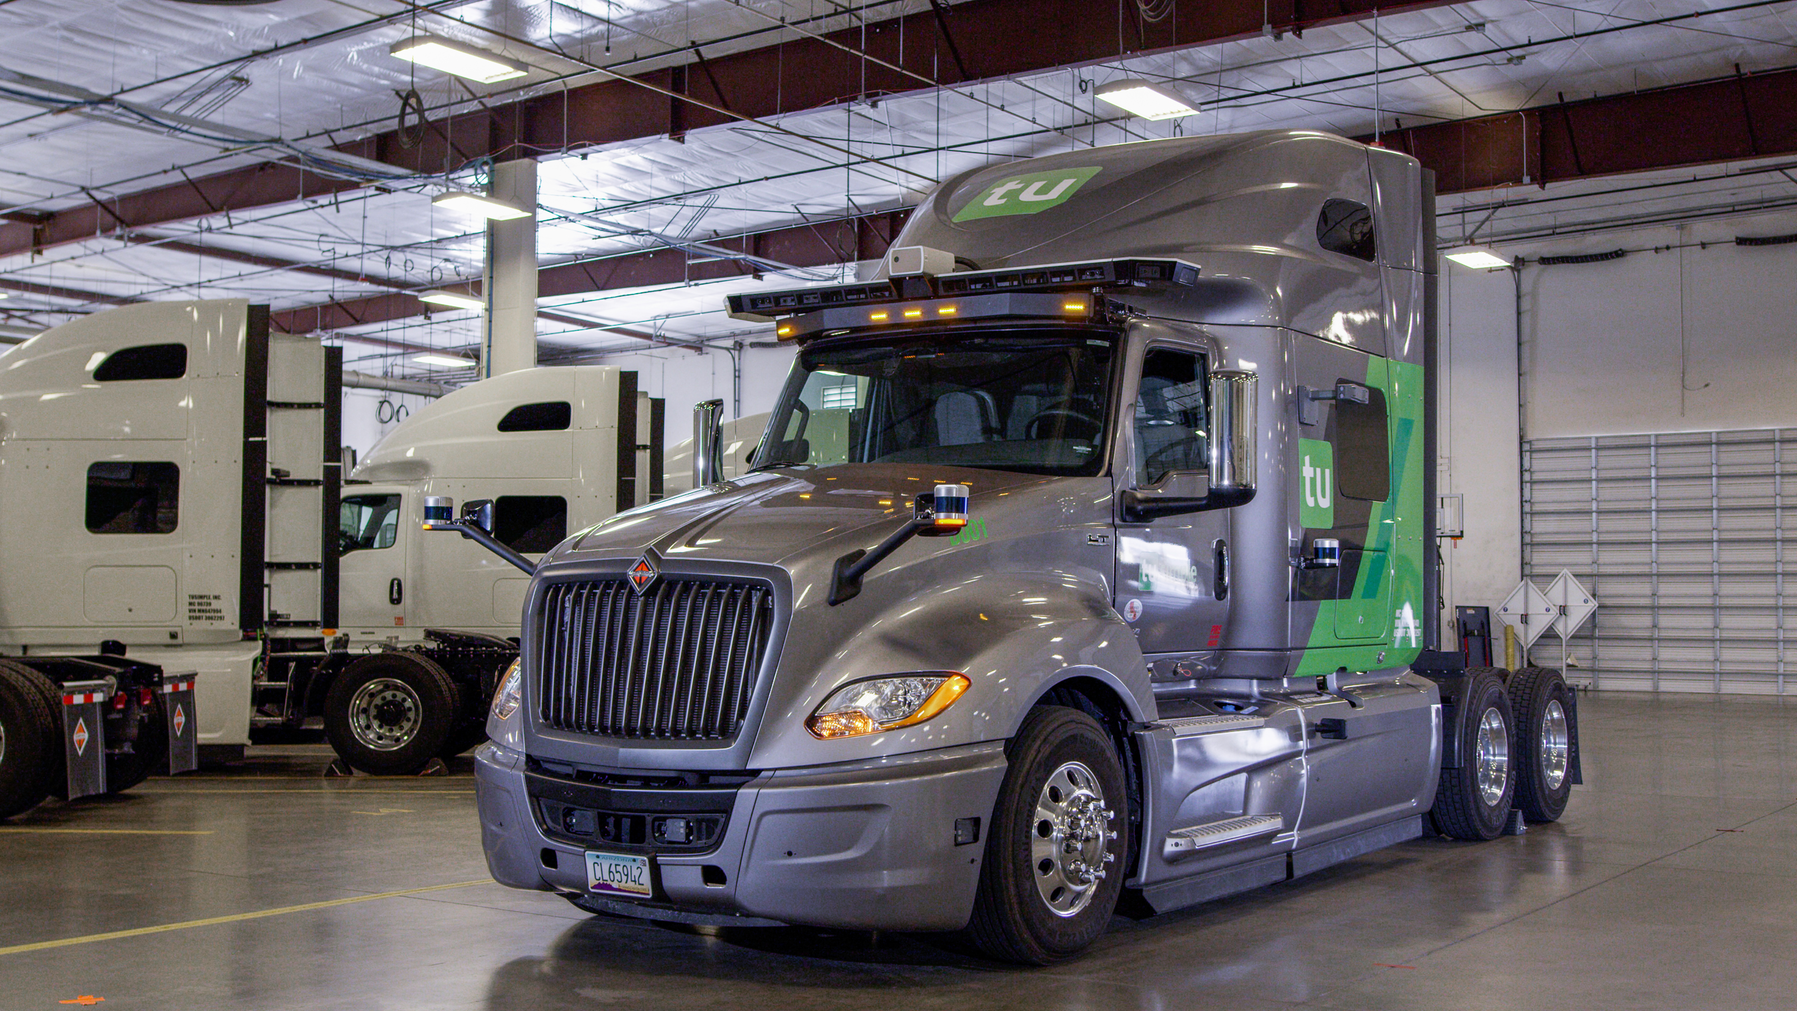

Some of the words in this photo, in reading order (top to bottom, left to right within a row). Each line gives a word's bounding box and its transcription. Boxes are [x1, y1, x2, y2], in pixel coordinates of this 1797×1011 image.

[983, 178, 1077, 206] tu
[1302, 454, 1331, 509] tu
[593, 861, 645, 886] CL65942
